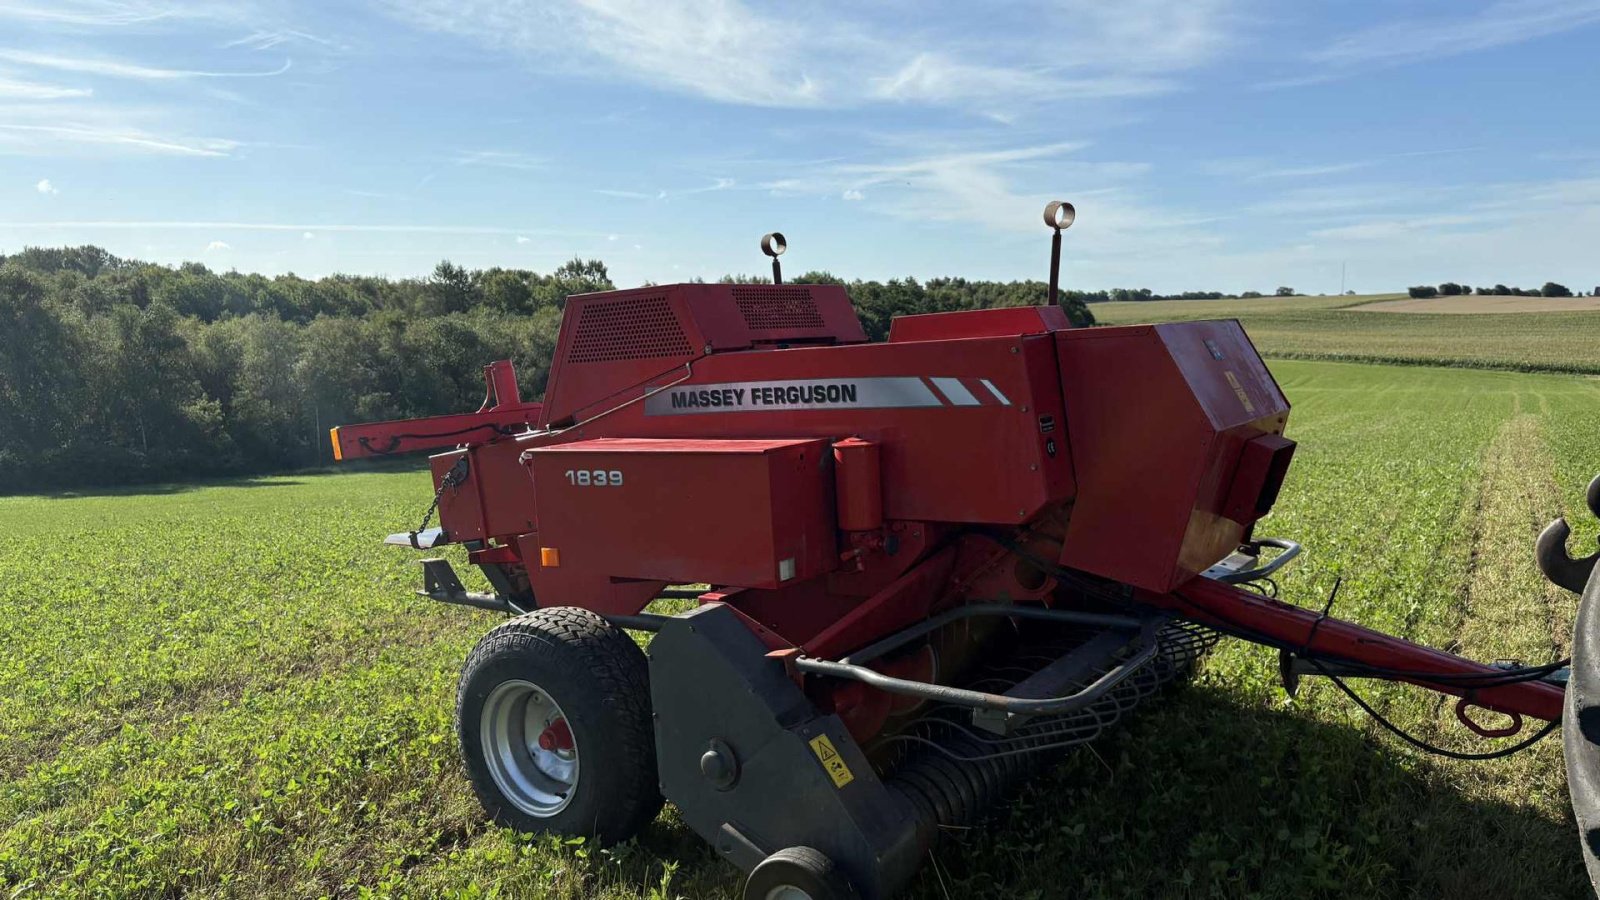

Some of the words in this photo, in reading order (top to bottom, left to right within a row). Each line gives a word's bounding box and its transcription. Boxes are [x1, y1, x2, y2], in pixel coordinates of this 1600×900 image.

[671, 388, 744, 409] MASSEY
[751, 384, 857, 405] FERGUSON
[565, 470, 623, 486] 1839
